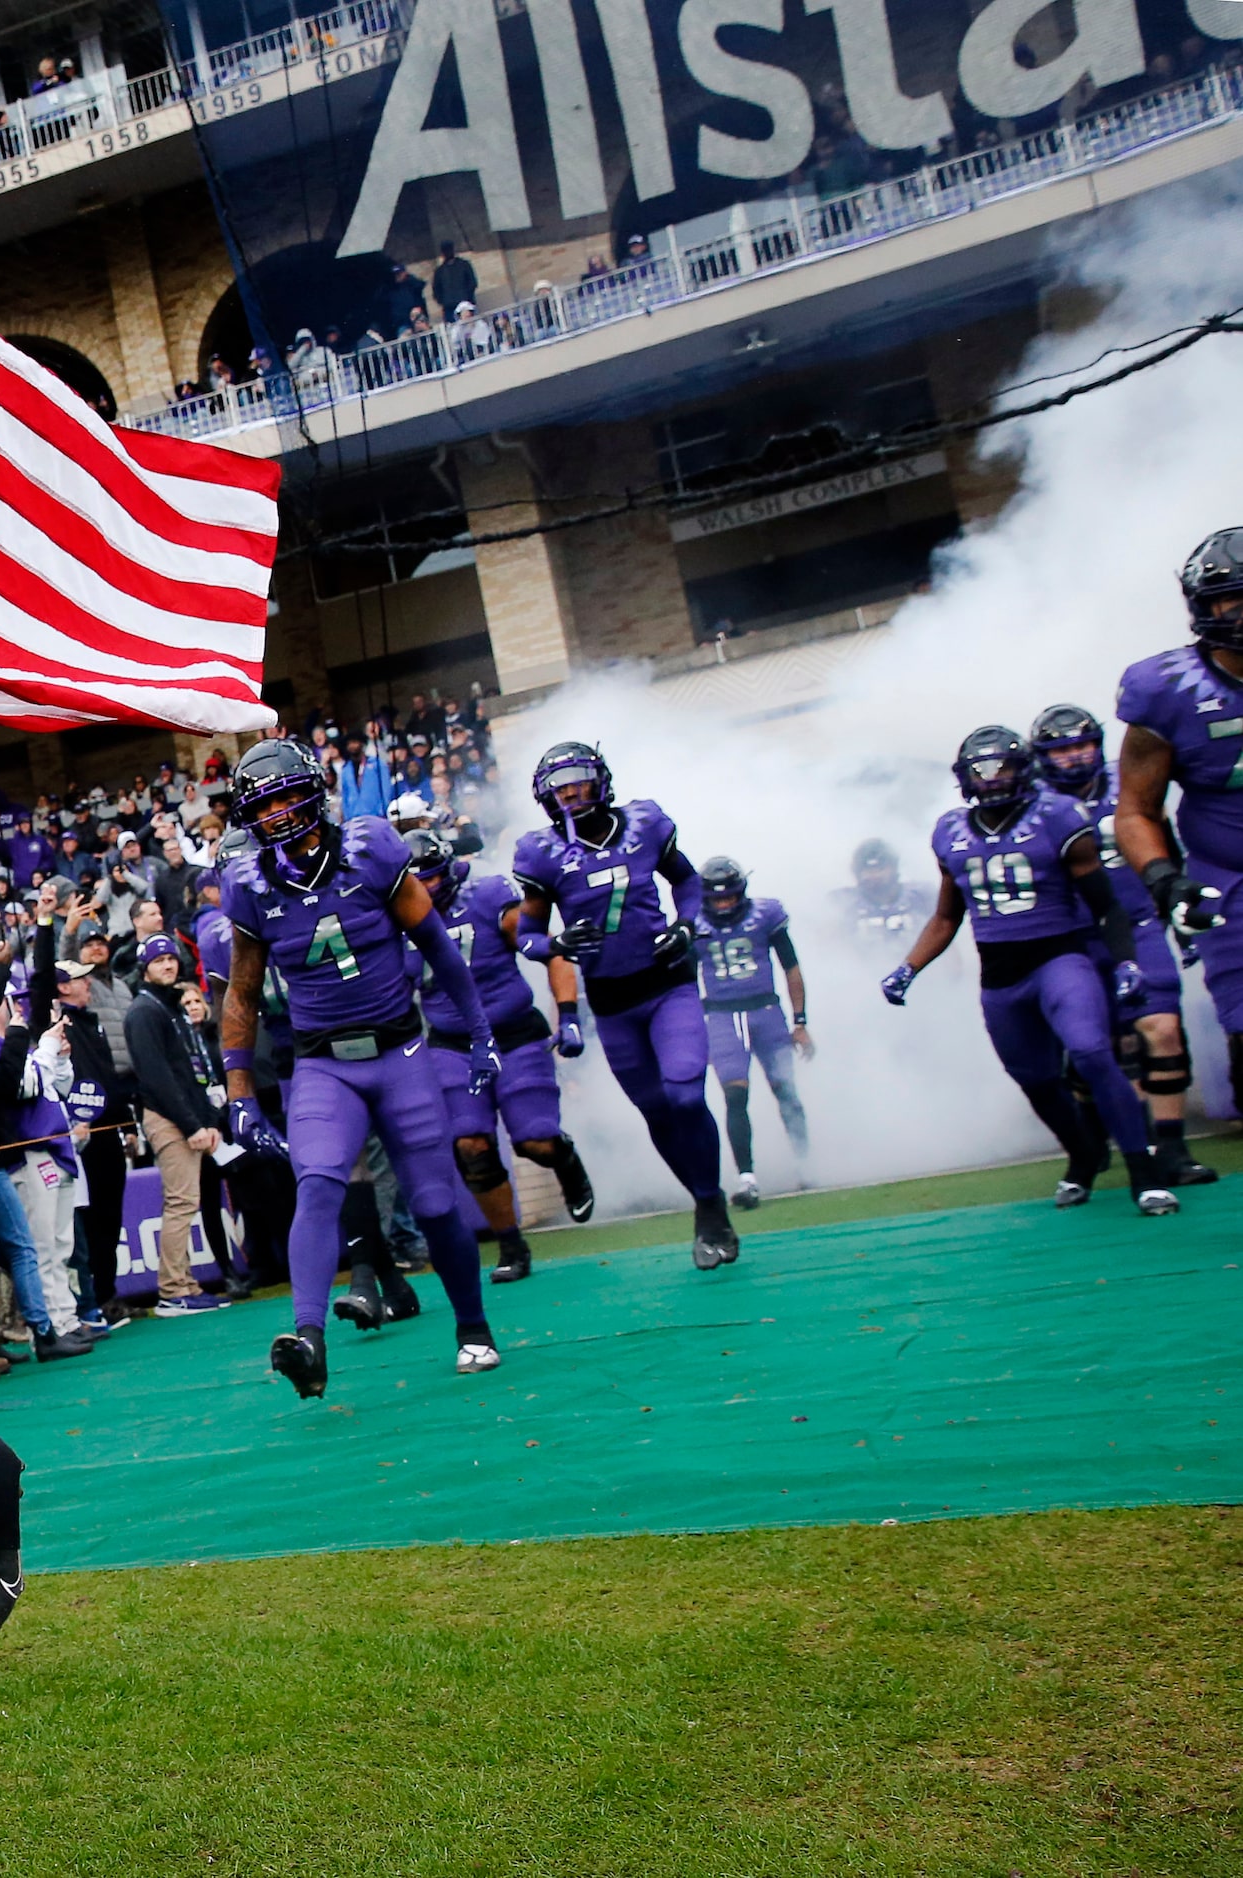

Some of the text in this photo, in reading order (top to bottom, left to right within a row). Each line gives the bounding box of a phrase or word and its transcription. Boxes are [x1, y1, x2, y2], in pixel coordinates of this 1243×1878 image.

[86, 122, 149, 158] 1958
[194, 83, 263, 121] 1959
[336, 0, 1243, 258] Allsta
[696, 459, 919, 533] WALSH COMPLEX
[585, 864, 630, 935] 7
[964, 851, 1038, 917] 10
[304, 913, 362, 981] 4
